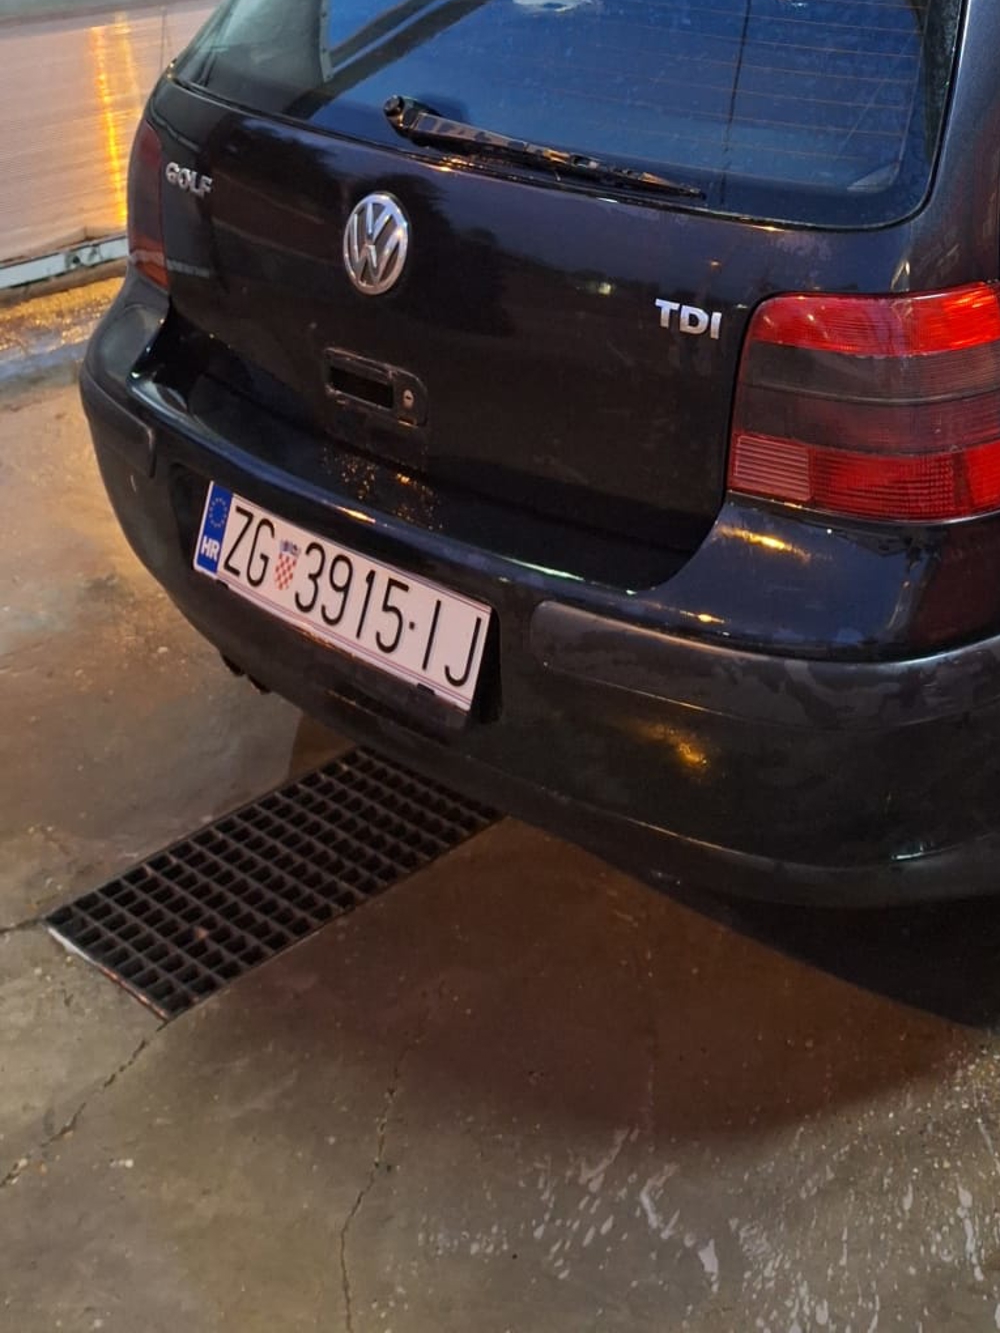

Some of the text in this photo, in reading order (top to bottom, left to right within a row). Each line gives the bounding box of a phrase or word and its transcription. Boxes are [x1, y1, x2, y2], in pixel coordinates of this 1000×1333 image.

[166, 161, 213, 199] GOLF
[655, 298, 722, 340] TDI
[200, 535, 221, 562] HR
[223, 505, 276, 588] ZG
